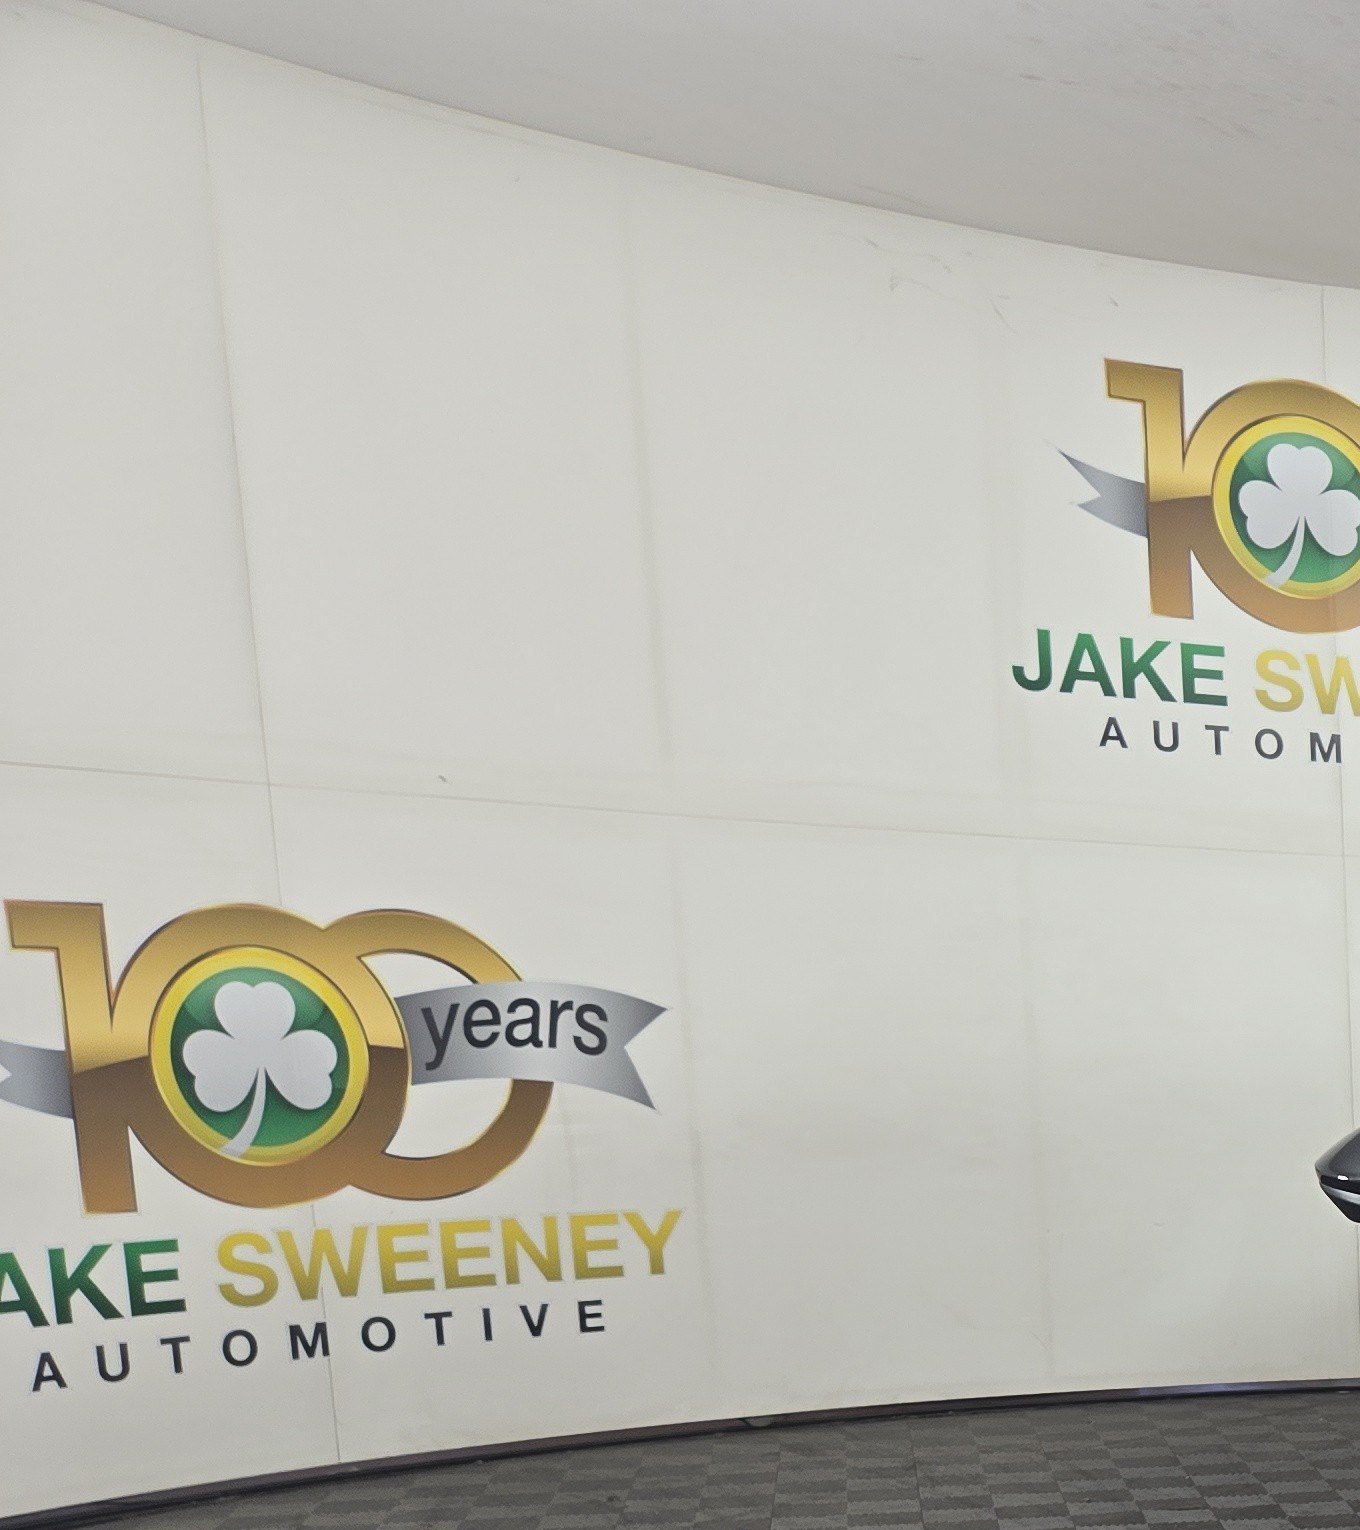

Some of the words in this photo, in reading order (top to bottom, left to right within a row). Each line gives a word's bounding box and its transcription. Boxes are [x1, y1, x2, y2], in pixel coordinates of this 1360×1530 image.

[1011, 628, 1229, 707] JAKE
[5, 900, 554, 1215] 100
[422, 998, 608, 1070] years
[217, 1209, 683, 1307] SWEENEY
[33, 1300, 605, 1391] AUTOMOTIVE
